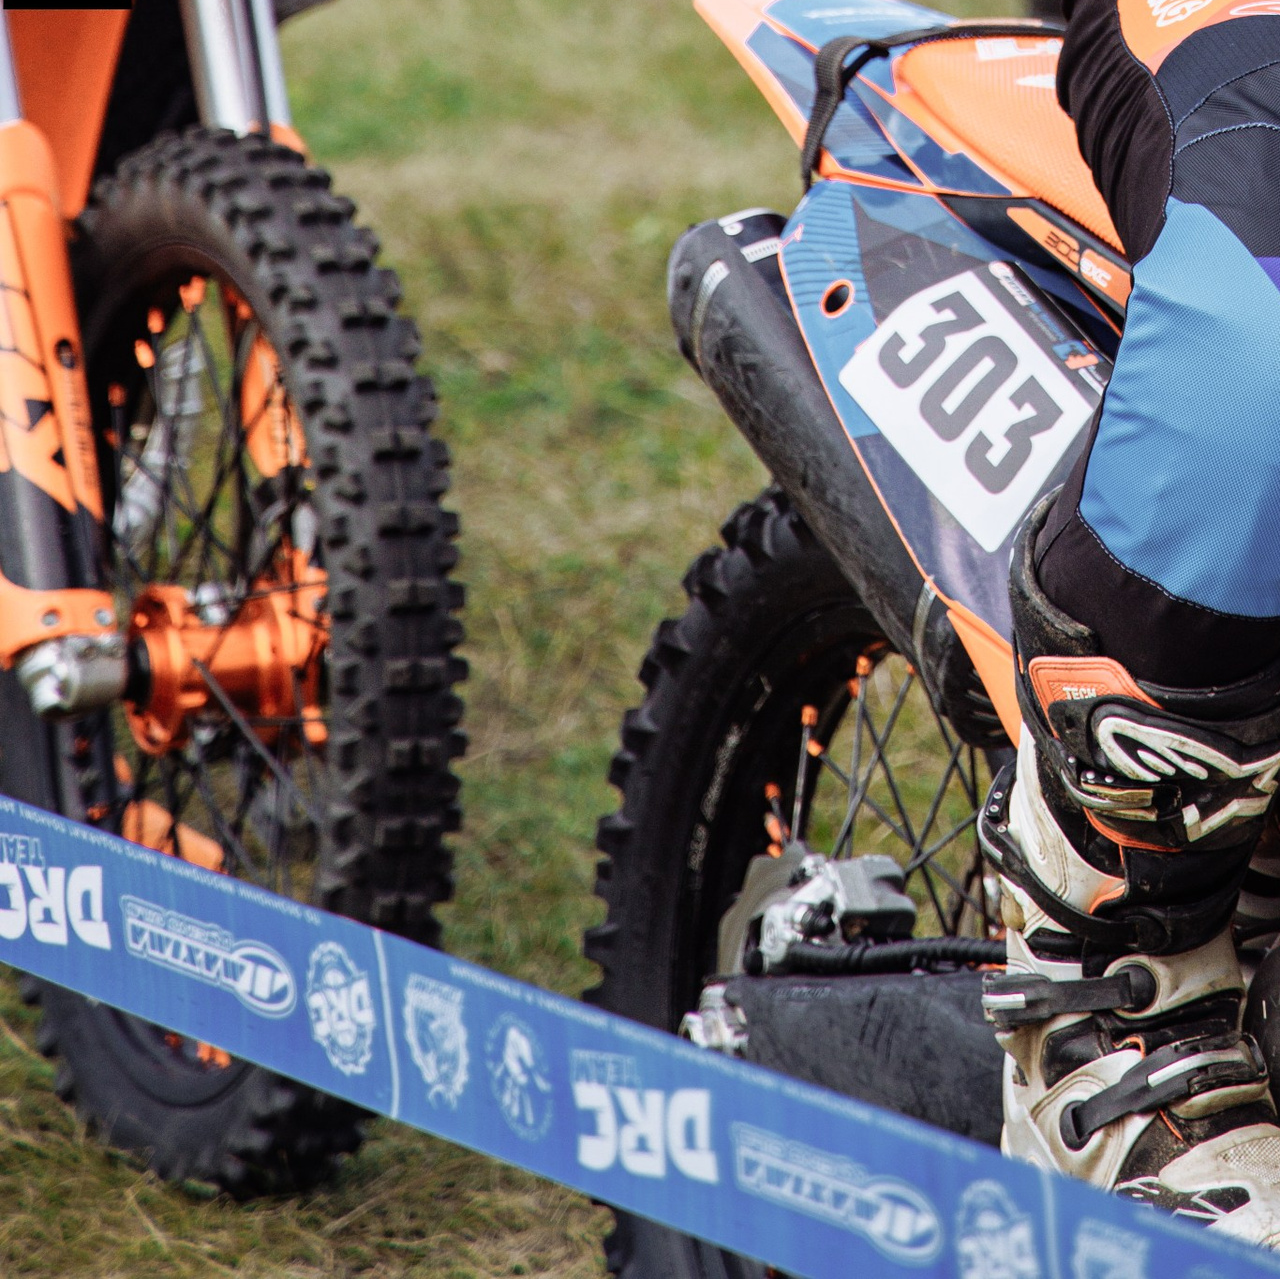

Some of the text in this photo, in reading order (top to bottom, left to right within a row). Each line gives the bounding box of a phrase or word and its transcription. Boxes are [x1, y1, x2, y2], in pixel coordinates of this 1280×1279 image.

[878, 291, 1063, 494] 303
[1062, 687, 1097, 700] TECH
[0, 861, 111, 950] DRC
[574, 1081, 719, 1185] DRC
